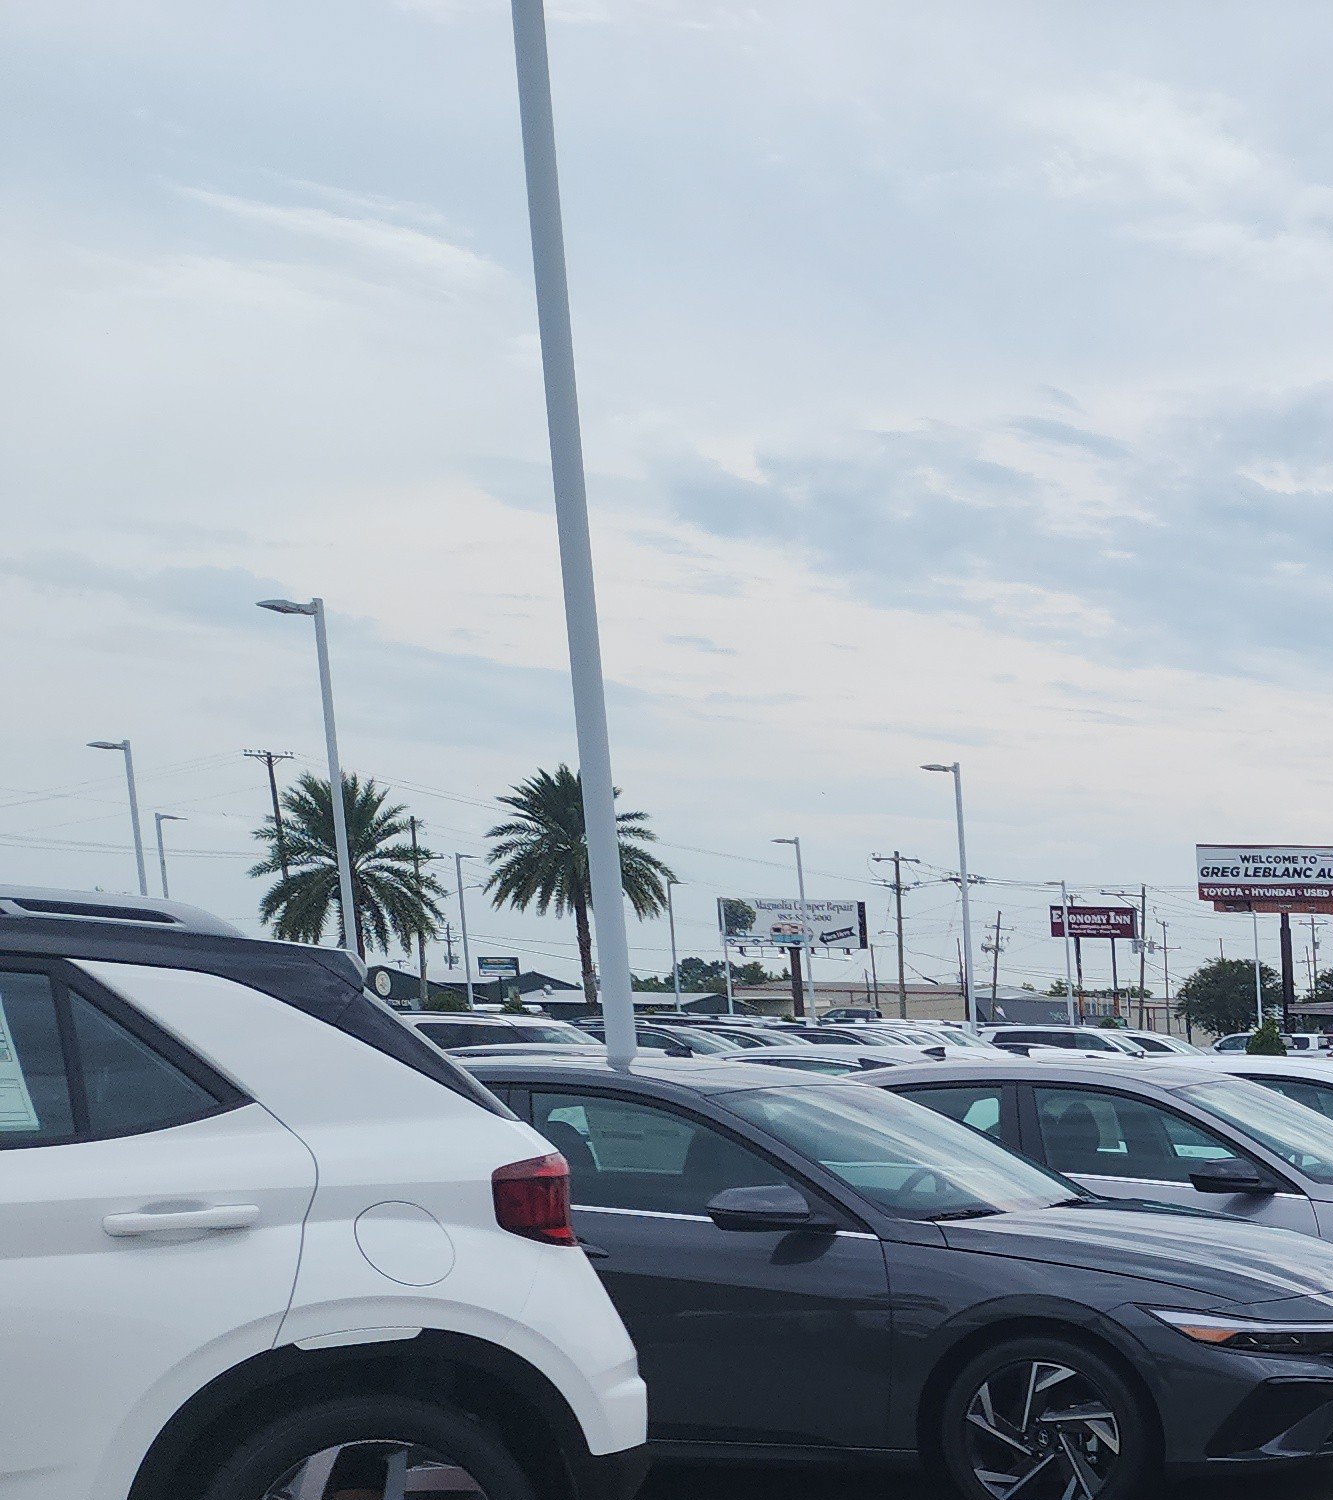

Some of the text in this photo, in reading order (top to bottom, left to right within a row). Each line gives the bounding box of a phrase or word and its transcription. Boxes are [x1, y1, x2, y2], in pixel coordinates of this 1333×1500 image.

[1239, 855, 1317, 864] WELCOME TO
[1200, 867, 1240, 877] GREG
[1244, 867, 1314, 878] LEBLANC
[1202, 887, 1243, 896] TOYOTA
[1251, 887, 1296, 897] HYUNDAI
[1303, 888, 1329, 897] USED
[794, 900, 824, 914] Cmper
[1051, 910, 1107, 924] EONOMY
